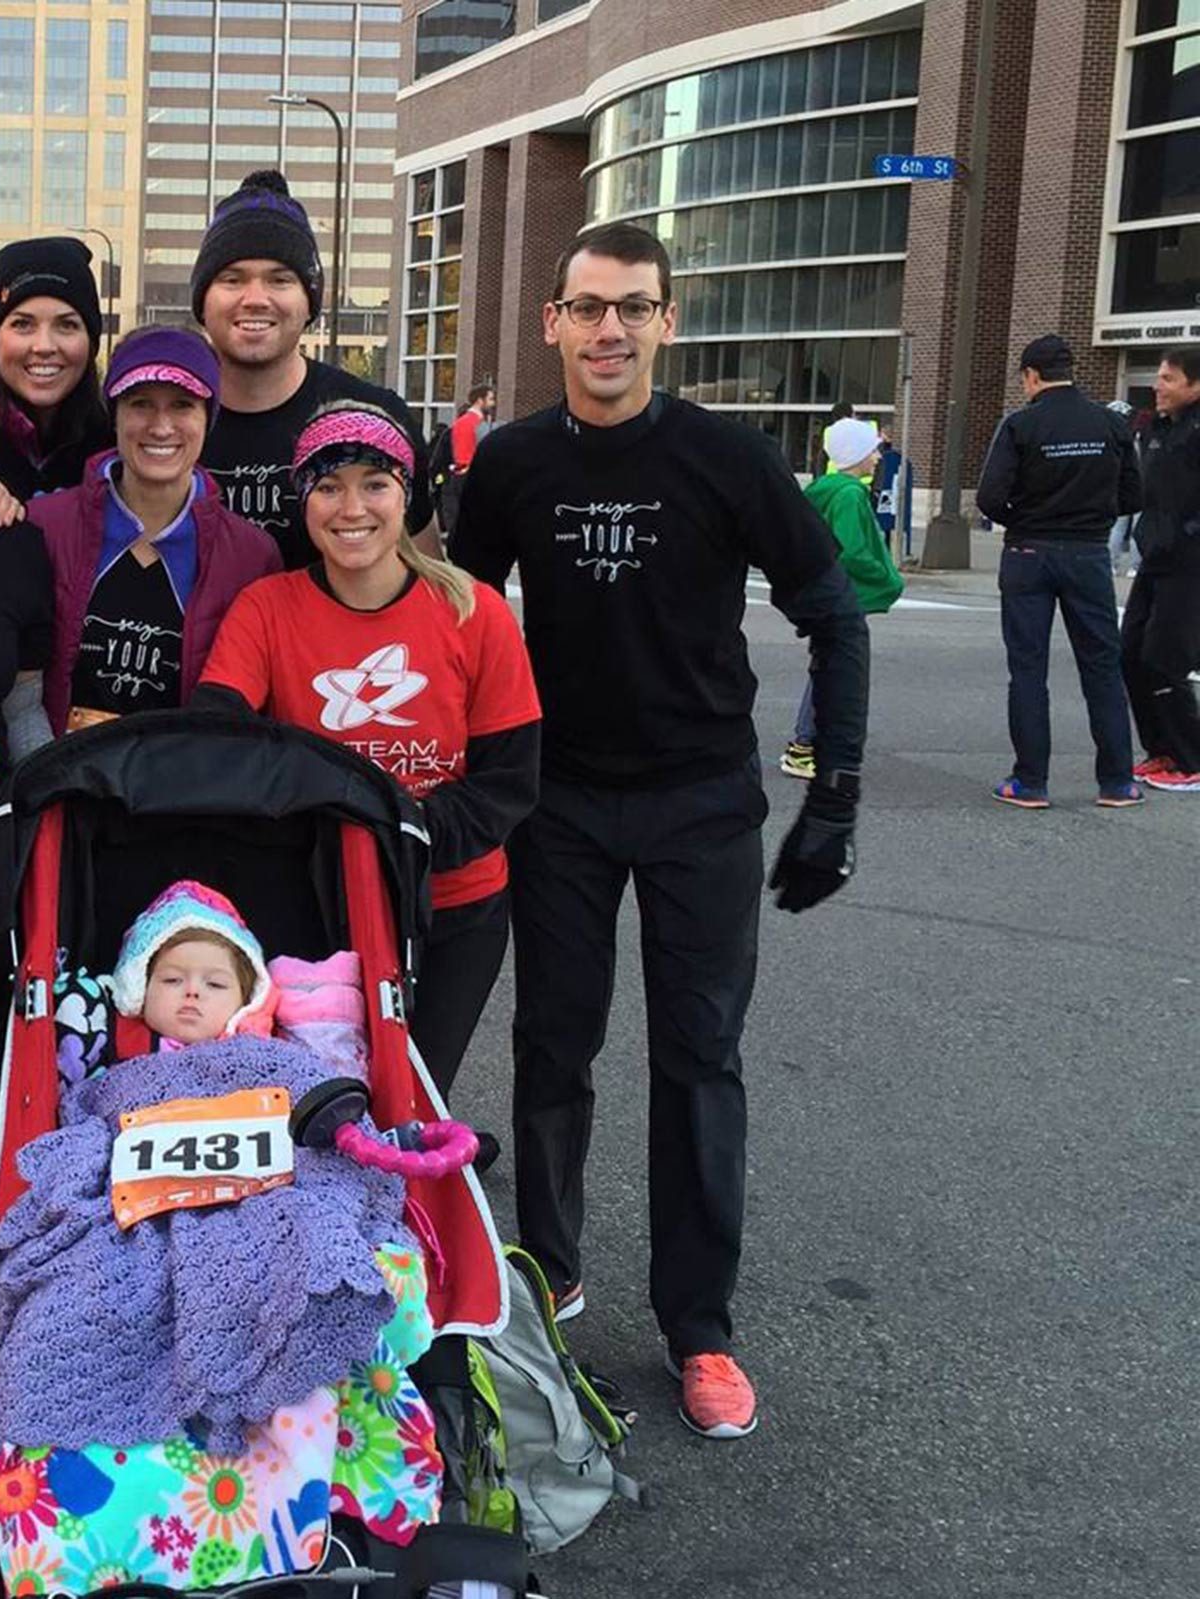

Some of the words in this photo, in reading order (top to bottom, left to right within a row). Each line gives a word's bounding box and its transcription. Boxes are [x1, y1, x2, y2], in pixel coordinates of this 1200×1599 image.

[882, 158, 892, 173] S
[901, 159, 924, 174] 6th
[933, 160, 949, 174] St
[226, 484, 281, 513] YOUR
[581, 523, 635, 553] YOUR
[575, 557, 642, 582] joy
[83, 614, 183, 642] seize
[106, 638, 161, 675] YOUR
[96, 669, 166, 697] joy
[344, 739, 438, 758] TEAM
[130, 1131, 272, 1171] 1431
